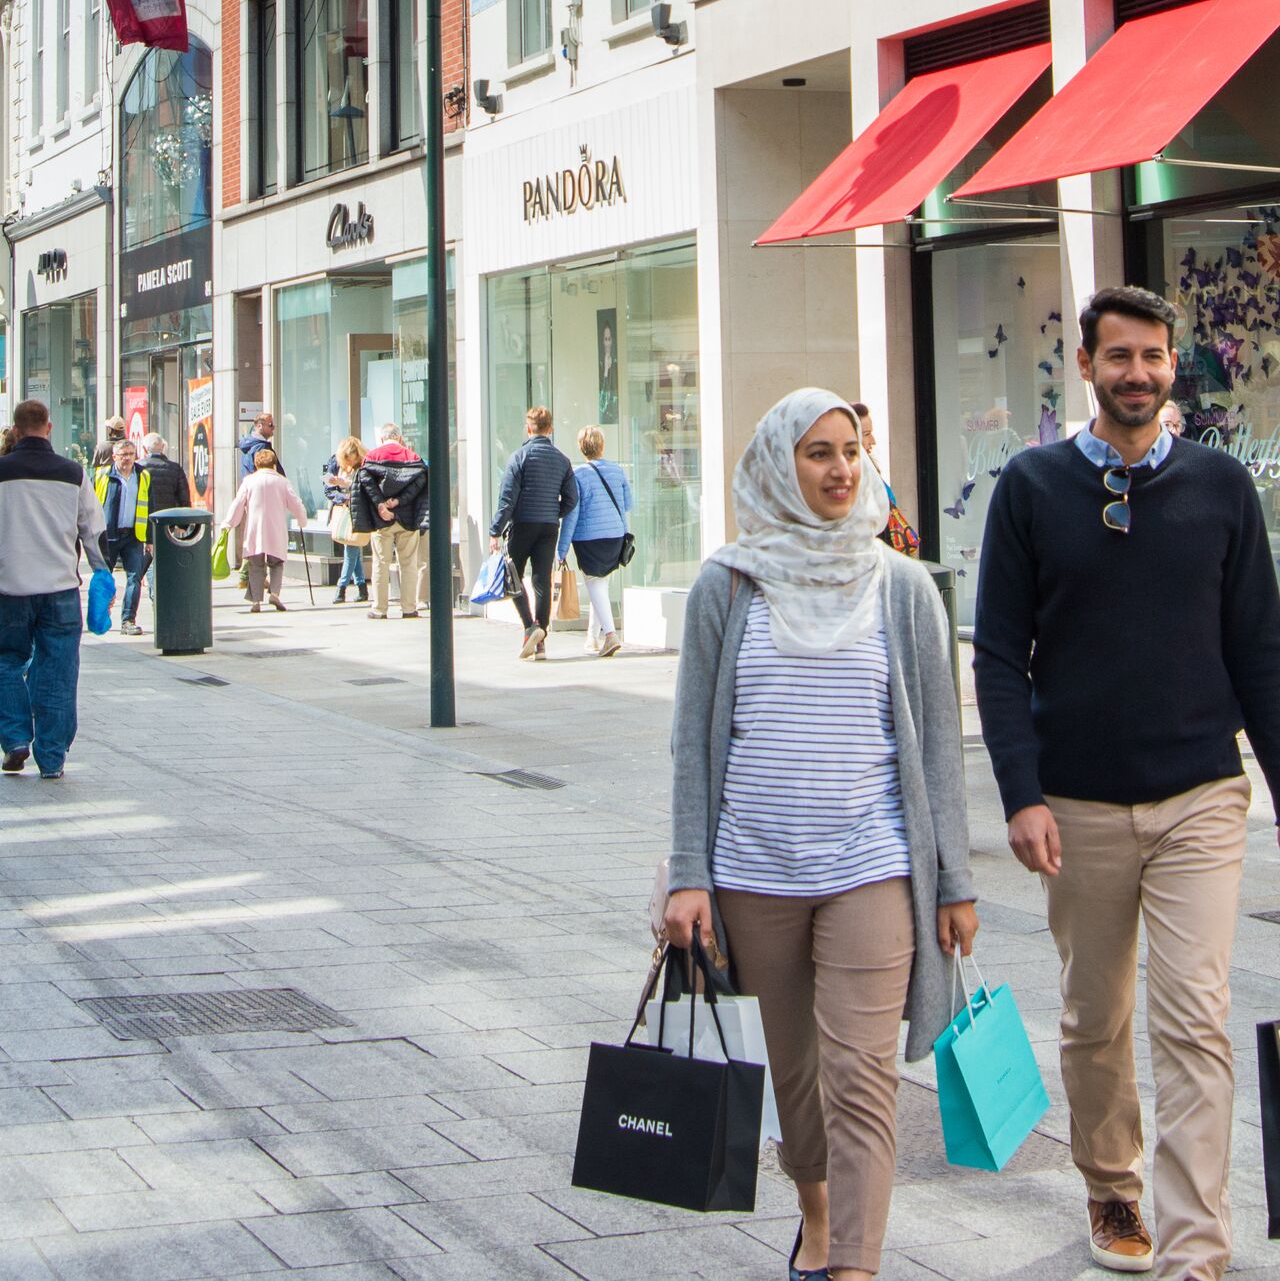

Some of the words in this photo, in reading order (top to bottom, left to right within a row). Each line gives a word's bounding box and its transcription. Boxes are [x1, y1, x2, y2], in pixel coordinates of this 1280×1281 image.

[523, 154, 626, 222] PANDORA
[326, 201, 374, 248] Clarks
[138, 267, 166, 293] PAMELA
[167, 259, 192, 284] SCOTT
[618, 1114, 673, 1137] CHANEL
